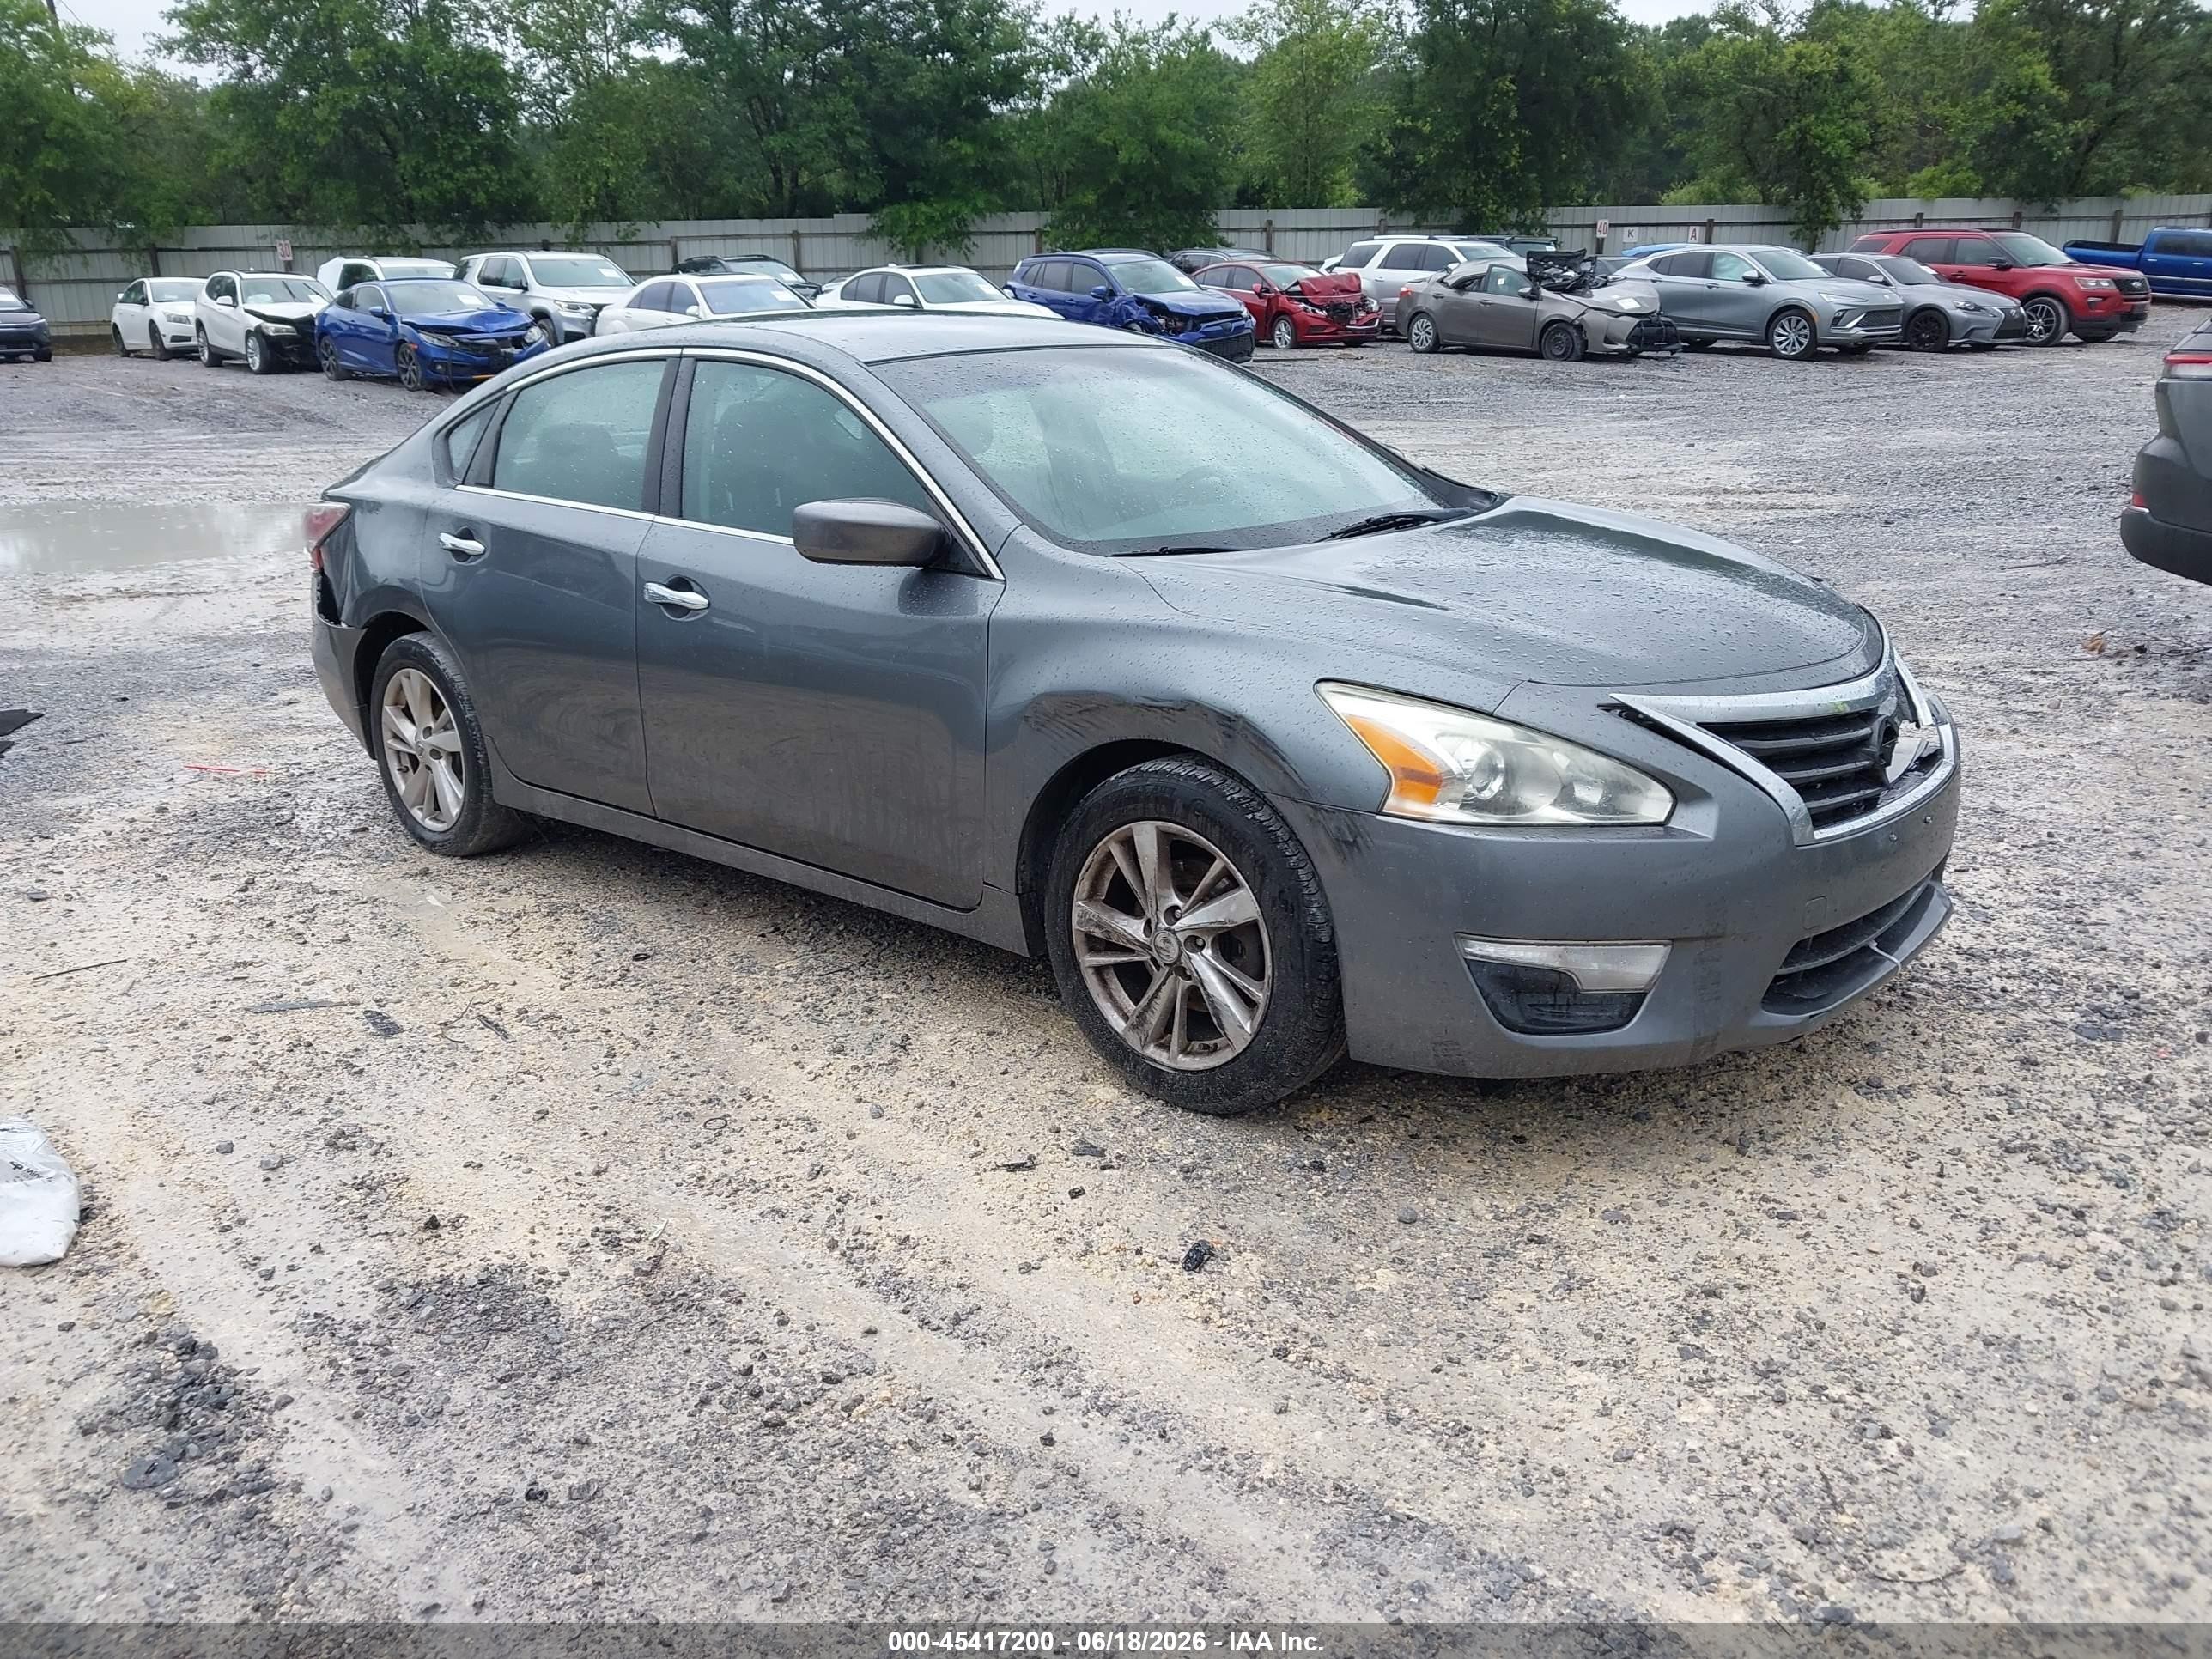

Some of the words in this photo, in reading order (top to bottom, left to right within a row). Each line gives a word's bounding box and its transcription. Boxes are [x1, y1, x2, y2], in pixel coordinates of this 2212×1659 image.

[1597, 222, 1607, 235] 40
[1627, 228, 1634, 239] K
[1690, 228, 1697, 241] A
[278, 242, 290, 258] 30
